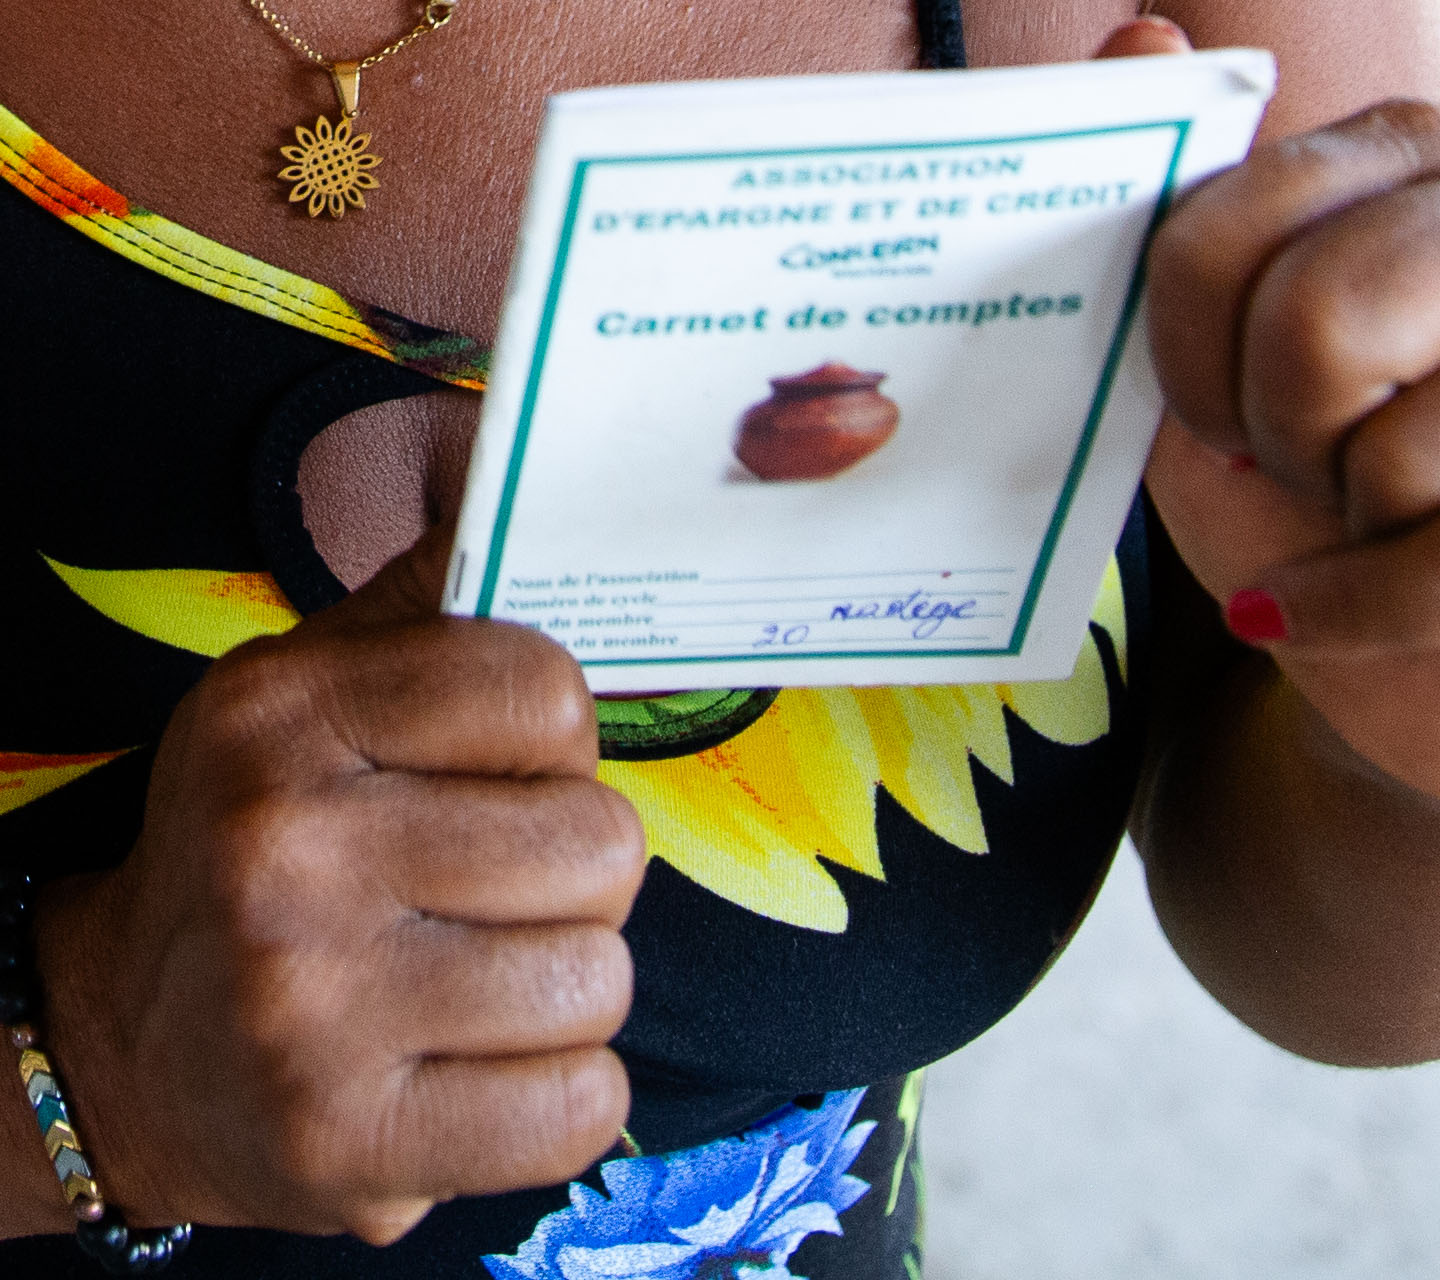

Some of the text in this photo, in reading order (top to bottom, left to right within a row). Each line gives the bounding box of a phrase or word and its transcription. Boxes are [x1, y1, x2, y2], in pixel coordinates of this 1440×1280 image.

[730, 154, 1023, 191] ASSOCIATION
[592, 178, 1134, 234] D'EPARGNE ET DE CRÉDIT
[594, 291, 1084, 337] Carnet de comptes
[558, 573, 579, 587] de
[583, 592, 605, 607] de
[610, 589, 657, 609] cycle
[578, 613, 653, 628] membre
[604, 634, 678, 649] membre
